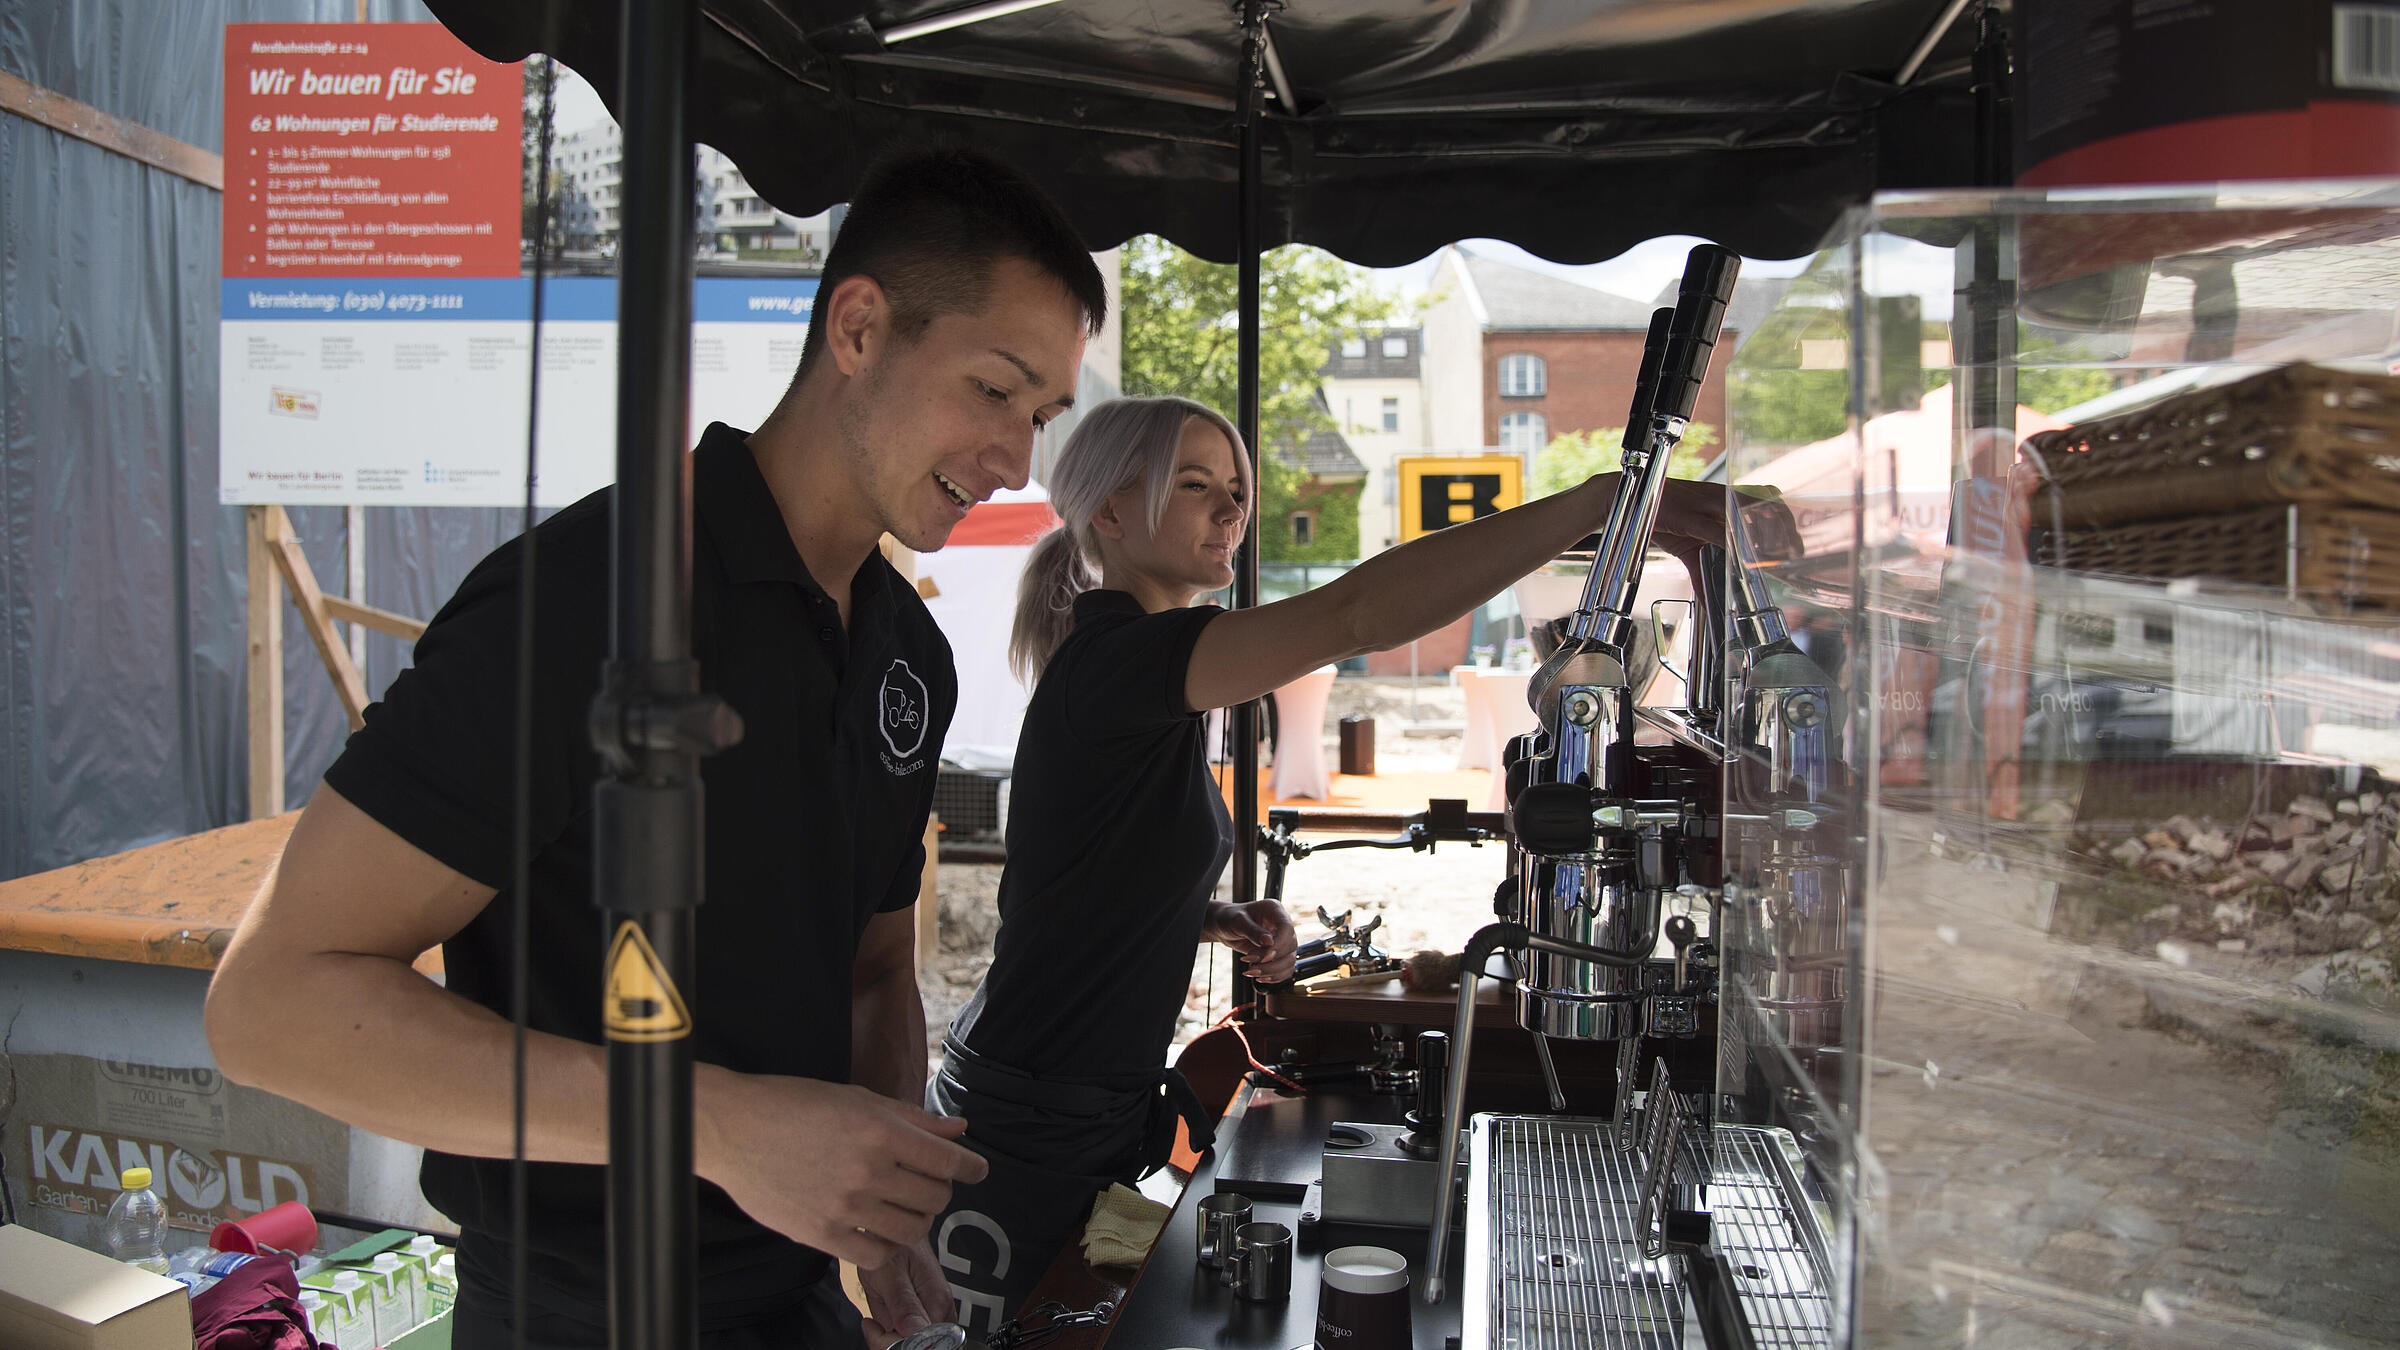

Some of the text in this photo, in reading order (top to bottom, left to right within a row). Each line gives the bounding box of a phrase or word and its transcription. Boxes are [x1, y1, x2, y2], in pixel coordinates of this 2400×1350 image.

[250, 66, 477, 101] Wir bauen für Sie
[250, 113, 499, 136] 62 Wohnungen für Studierende
[281, 146, 299, 159] bis
[413, 145, 431, 159] für
[267, 161, 331, 174] Studierende
[319, 176, 381, 189] Wohnfläche
[266, 191, 449, 207] barrierefreie Erschließung von allen
[266, 206, 345, 220] Wohneinheiten
[266, 221, 493, 237] alle Wohnungen in den Obergeschossen mit
[266, 236, 375, 250] Balkon oder Terrasse
[266, 251, 463, 268] begrünter Innenhof mit Fahrradgarage
[249, 291, 340, 312] Vermietung:
[343, 289, 386, 312] (030)
[131, 1087, 186, 1109] 700 Liter
[30, 1124, 309, 1215] KANOLD
